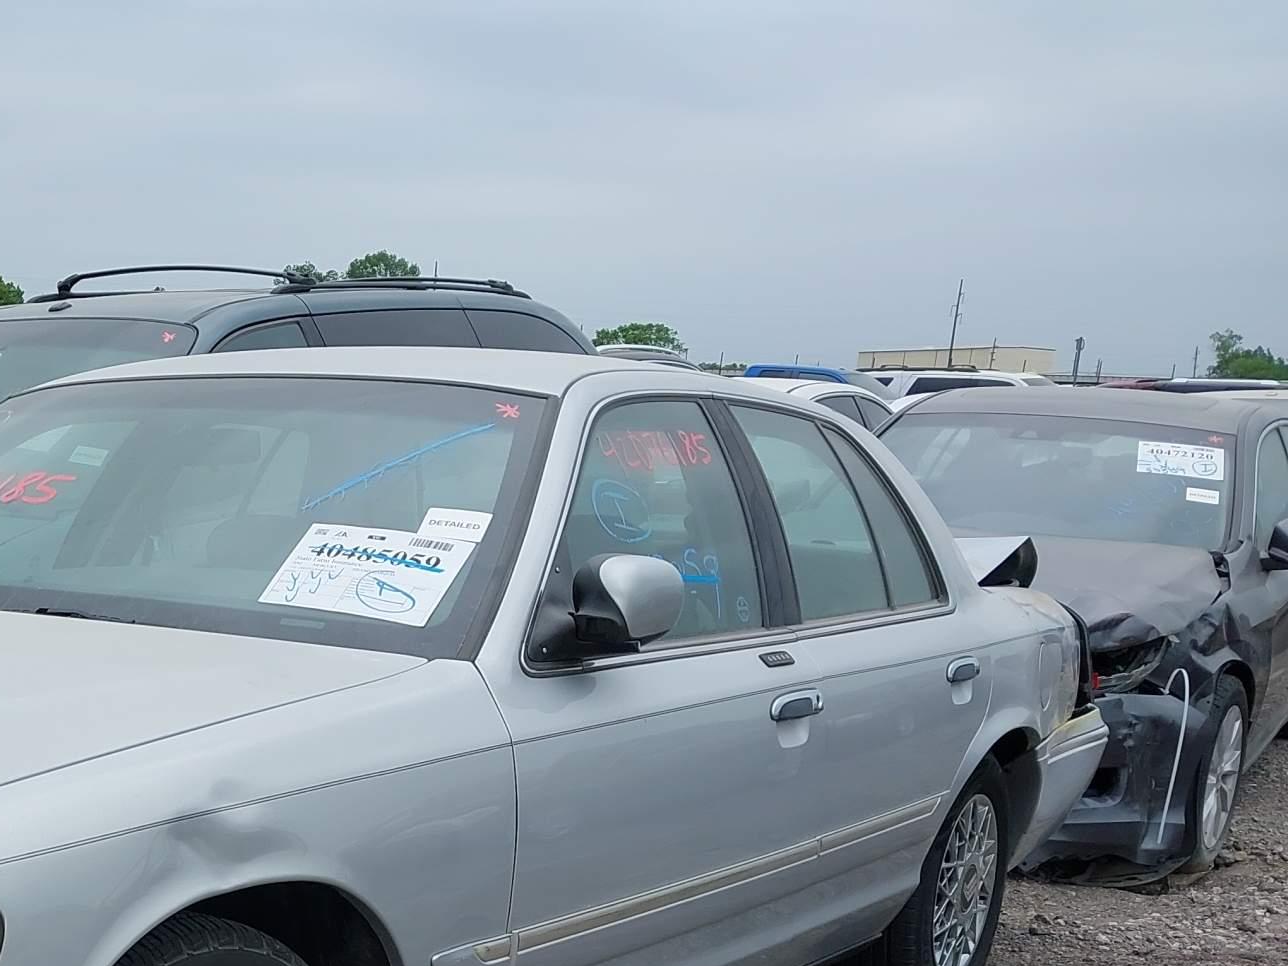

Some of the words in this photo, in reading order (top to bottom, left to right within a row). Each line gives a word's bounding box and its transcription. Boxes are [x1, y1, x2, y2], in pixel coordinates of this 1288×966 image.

[1145, 447, 1215, 460] 40472120
[428, 519, 481, 531] DETAILED
[310, 542, 443, 570] 40485059
